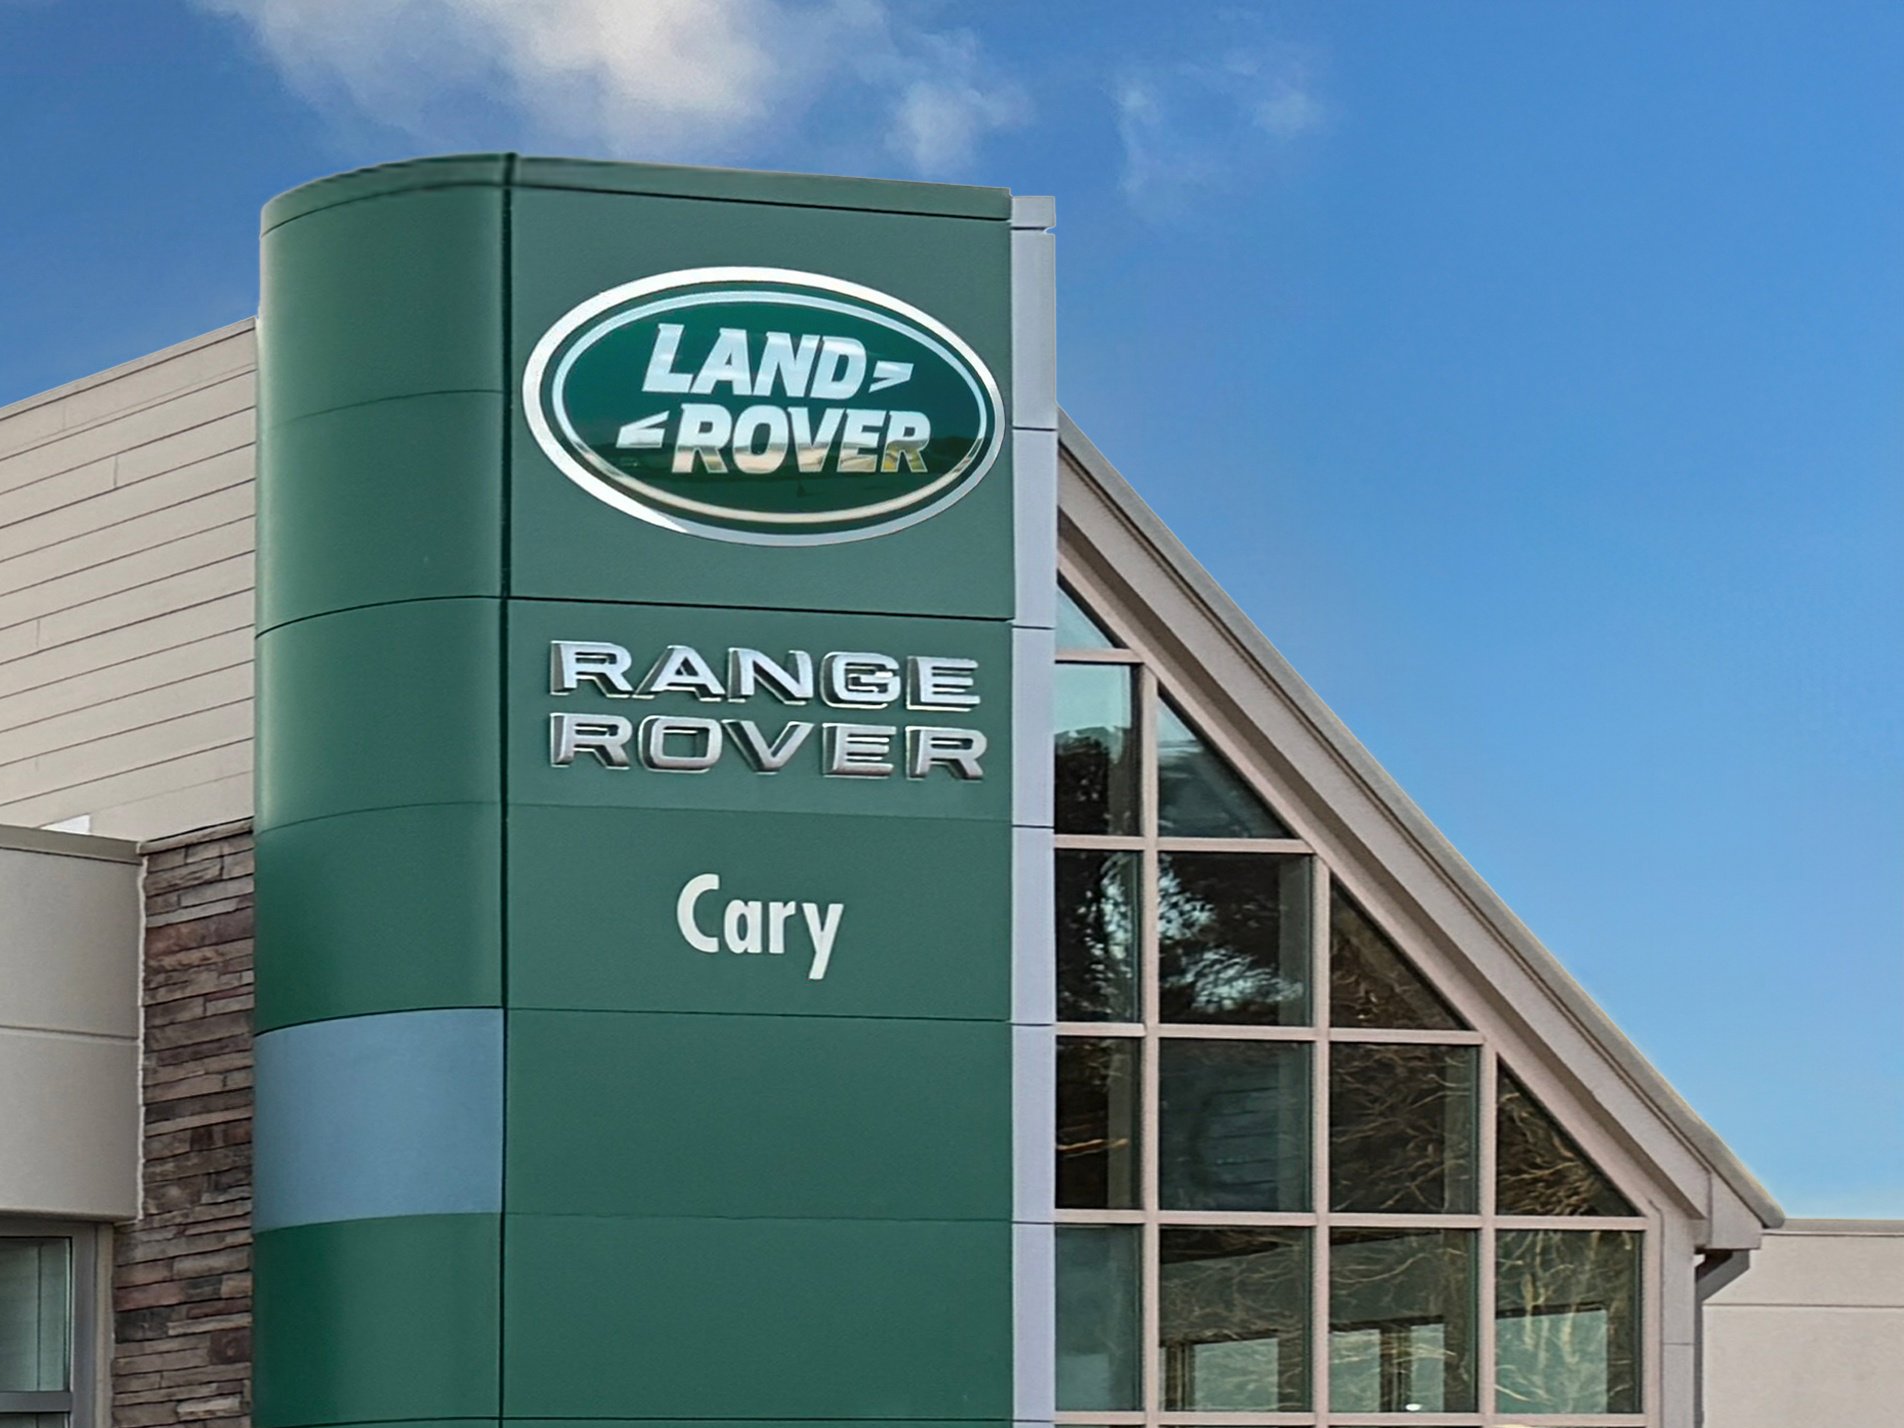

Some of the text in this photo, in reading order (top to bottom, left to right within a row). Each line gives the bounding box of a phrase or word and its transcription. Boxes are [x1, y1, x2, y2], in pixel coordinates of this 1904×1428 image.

[642, 323, 868, 401] LAND
[671, 403, 931, 474] ROVER
[550, 639, 981, 711] RANGE
[550, 712, 988, 780] ROVER
[676, 872, 845, 980] Cary
